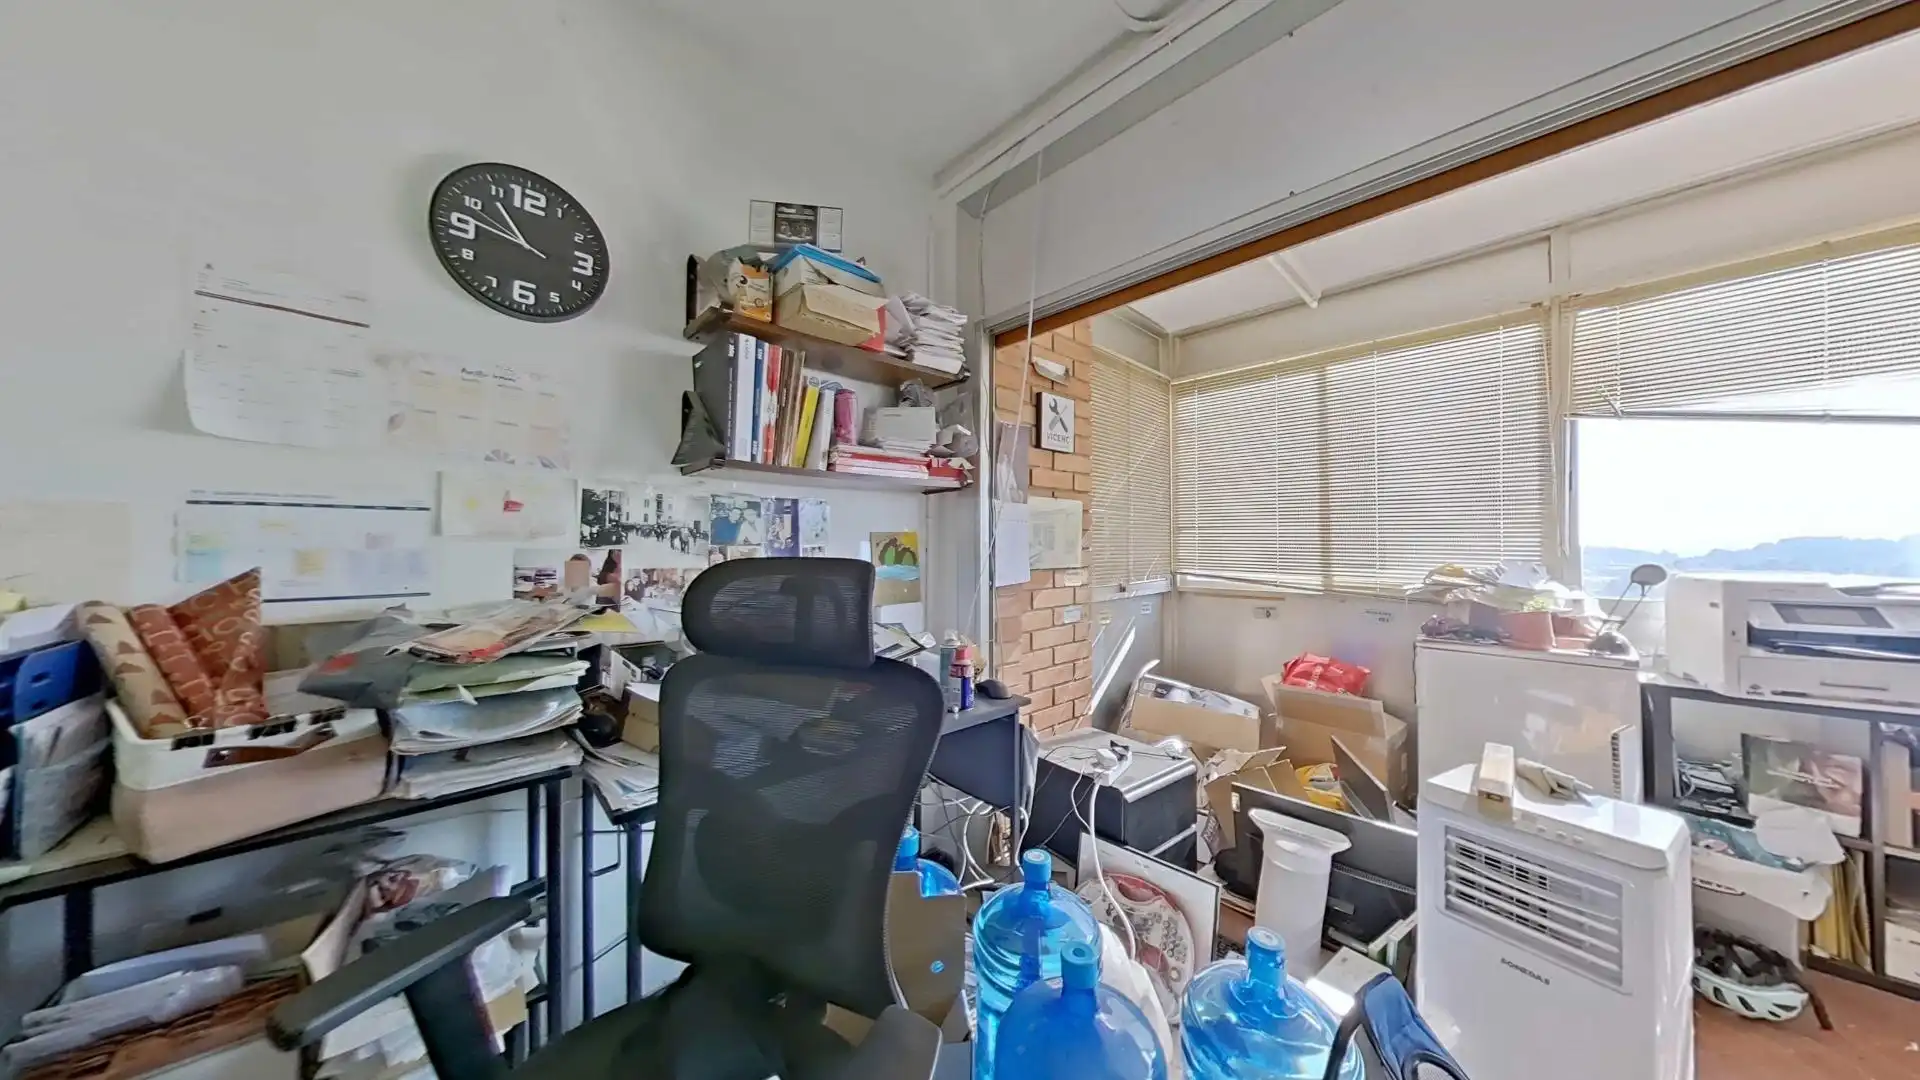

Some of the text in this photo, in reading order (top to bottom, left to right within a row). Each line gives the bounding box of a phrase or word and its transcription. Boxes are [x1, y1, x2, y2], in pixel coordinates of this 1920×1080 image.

[490, 184, 504, 198] 11
[463, 195, 482, 211] 10
[509, 183, 547, 217] 12
[556, 208, 562, 218] 1
[449, 211, 477, 240] 9
[574, 232, 584, 244] 2
[461, 248, 474, 261] 8
[572, 251, 593, 276] 3
[485, 275, 497, 288] 7
[572, 280, 582, 291] 4
[513, 279, 536, 305] 6
[550, 292, 560, 303] 5
